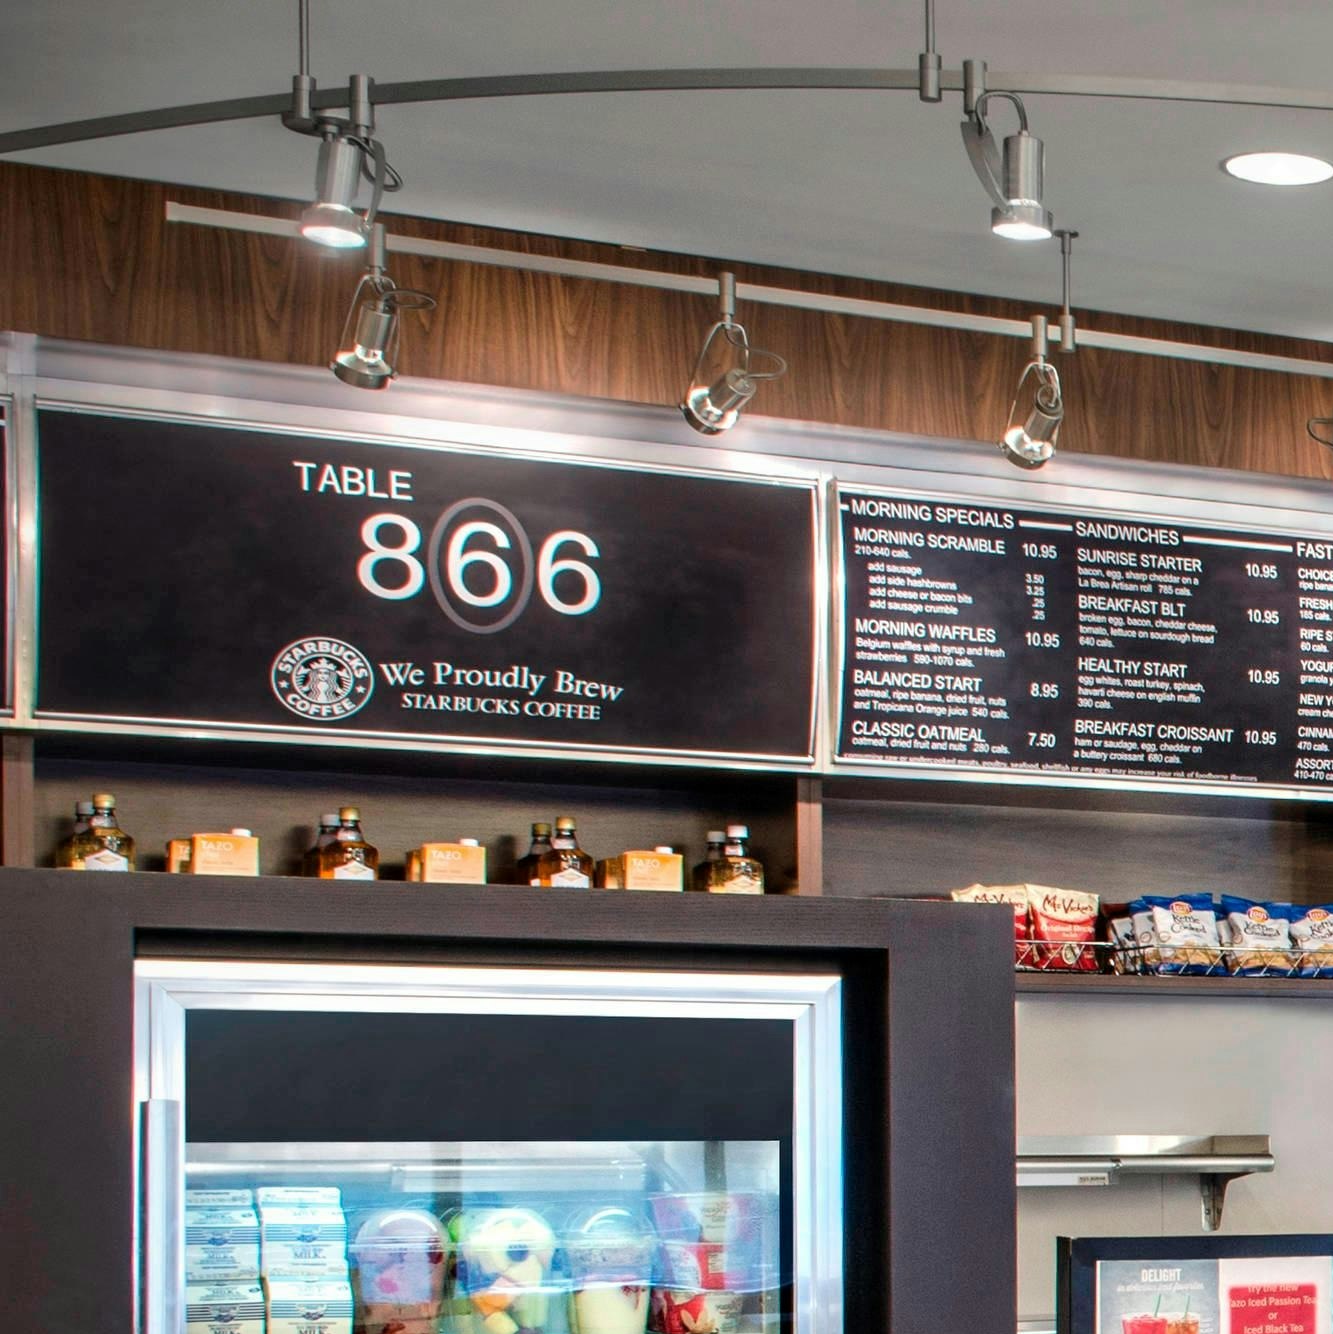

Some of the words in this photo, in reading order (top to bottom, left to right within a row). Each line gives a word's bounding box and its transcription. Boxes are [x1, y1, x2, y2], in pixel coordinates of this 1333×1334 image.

[292, 460, 414, 501] TABLE
[852, 499, 931, 521] MORNING
[935, 505, 1014, 529] SPECIALS
[854, 527, 924, 547] MORNING
[927, 533, 1006, 556] SCRAMBLE
[1022, 542, 1057, 560] 10.95
[1076, 521, 1179, 546] SANDWICHES
[356, 512, 602, 616] 866
[1077, 548, 1137, 566] SUNRISE
[1140, 554, 1202, 573] STARTER
[1246, 562, 1278, 579] 10.95
[1297, 541, 1333, 560] FAST
[1078, 595, 1158, 615] BREAKFAST
[1161, 602, 1186, 618] BLT
[1247, 608, 1279, 625] 10.95
[1299, 597, 1333, 612] FRESH
[855, 618, 926, 638] MORNING
[929, 623, 996, 643] WAFFLES
[1025, 631, 1060, 648] 10.95
[1300, 628, 1324, 641] RIPE
[277, 640, 369, 681] STARBUCKS
[1078, 657, 1140, 675] HEALTHY
[1143, 662, 1188, 679] START
[1248, 669, 1280, 685] 10.95
[379, 661, 425, 686] We
[433, 662, 547, 696] Proudly
[554, 670, 624, 702] Brew
[853, 669, 931, 690] BALANCED
[935, 674, 982, 692] START
[1030, 683, 1059, 699] 8.95
[286, 692, 356, 718] COFFEE
[402, 692, 521, 716] STARBUCKS
[524, 700, 601, 721] COFFEE
[872, 700, 914, 715] Tropicana
[915, 702, 947, 718] Orange
[948, 704, 968, 719] juice
[852, 720, 916, 739] CLASSIC
[918, 724, 986, 744] OATMEAL
[1028, 731, 1056, 748] 7.50
[1075, 719, 1154, 738] BREAKFAST
[1158, 724, 1234, 744] CROISSANT
[1245, 730, 1277, 746] 10.95
[1141, 1268, 1182, 1282] DELIGHT
[1248, 1297, 1267, 1307] Iced
[1268, 1296, 1301, 1307] Passion
[1268, 1311, 1278, 1320] or
[1244, 1325, 1263, 1334] Iced
[1265, 1323, 1288, 1334] Black
[1290, 1323, 1304, 1333] Tea
